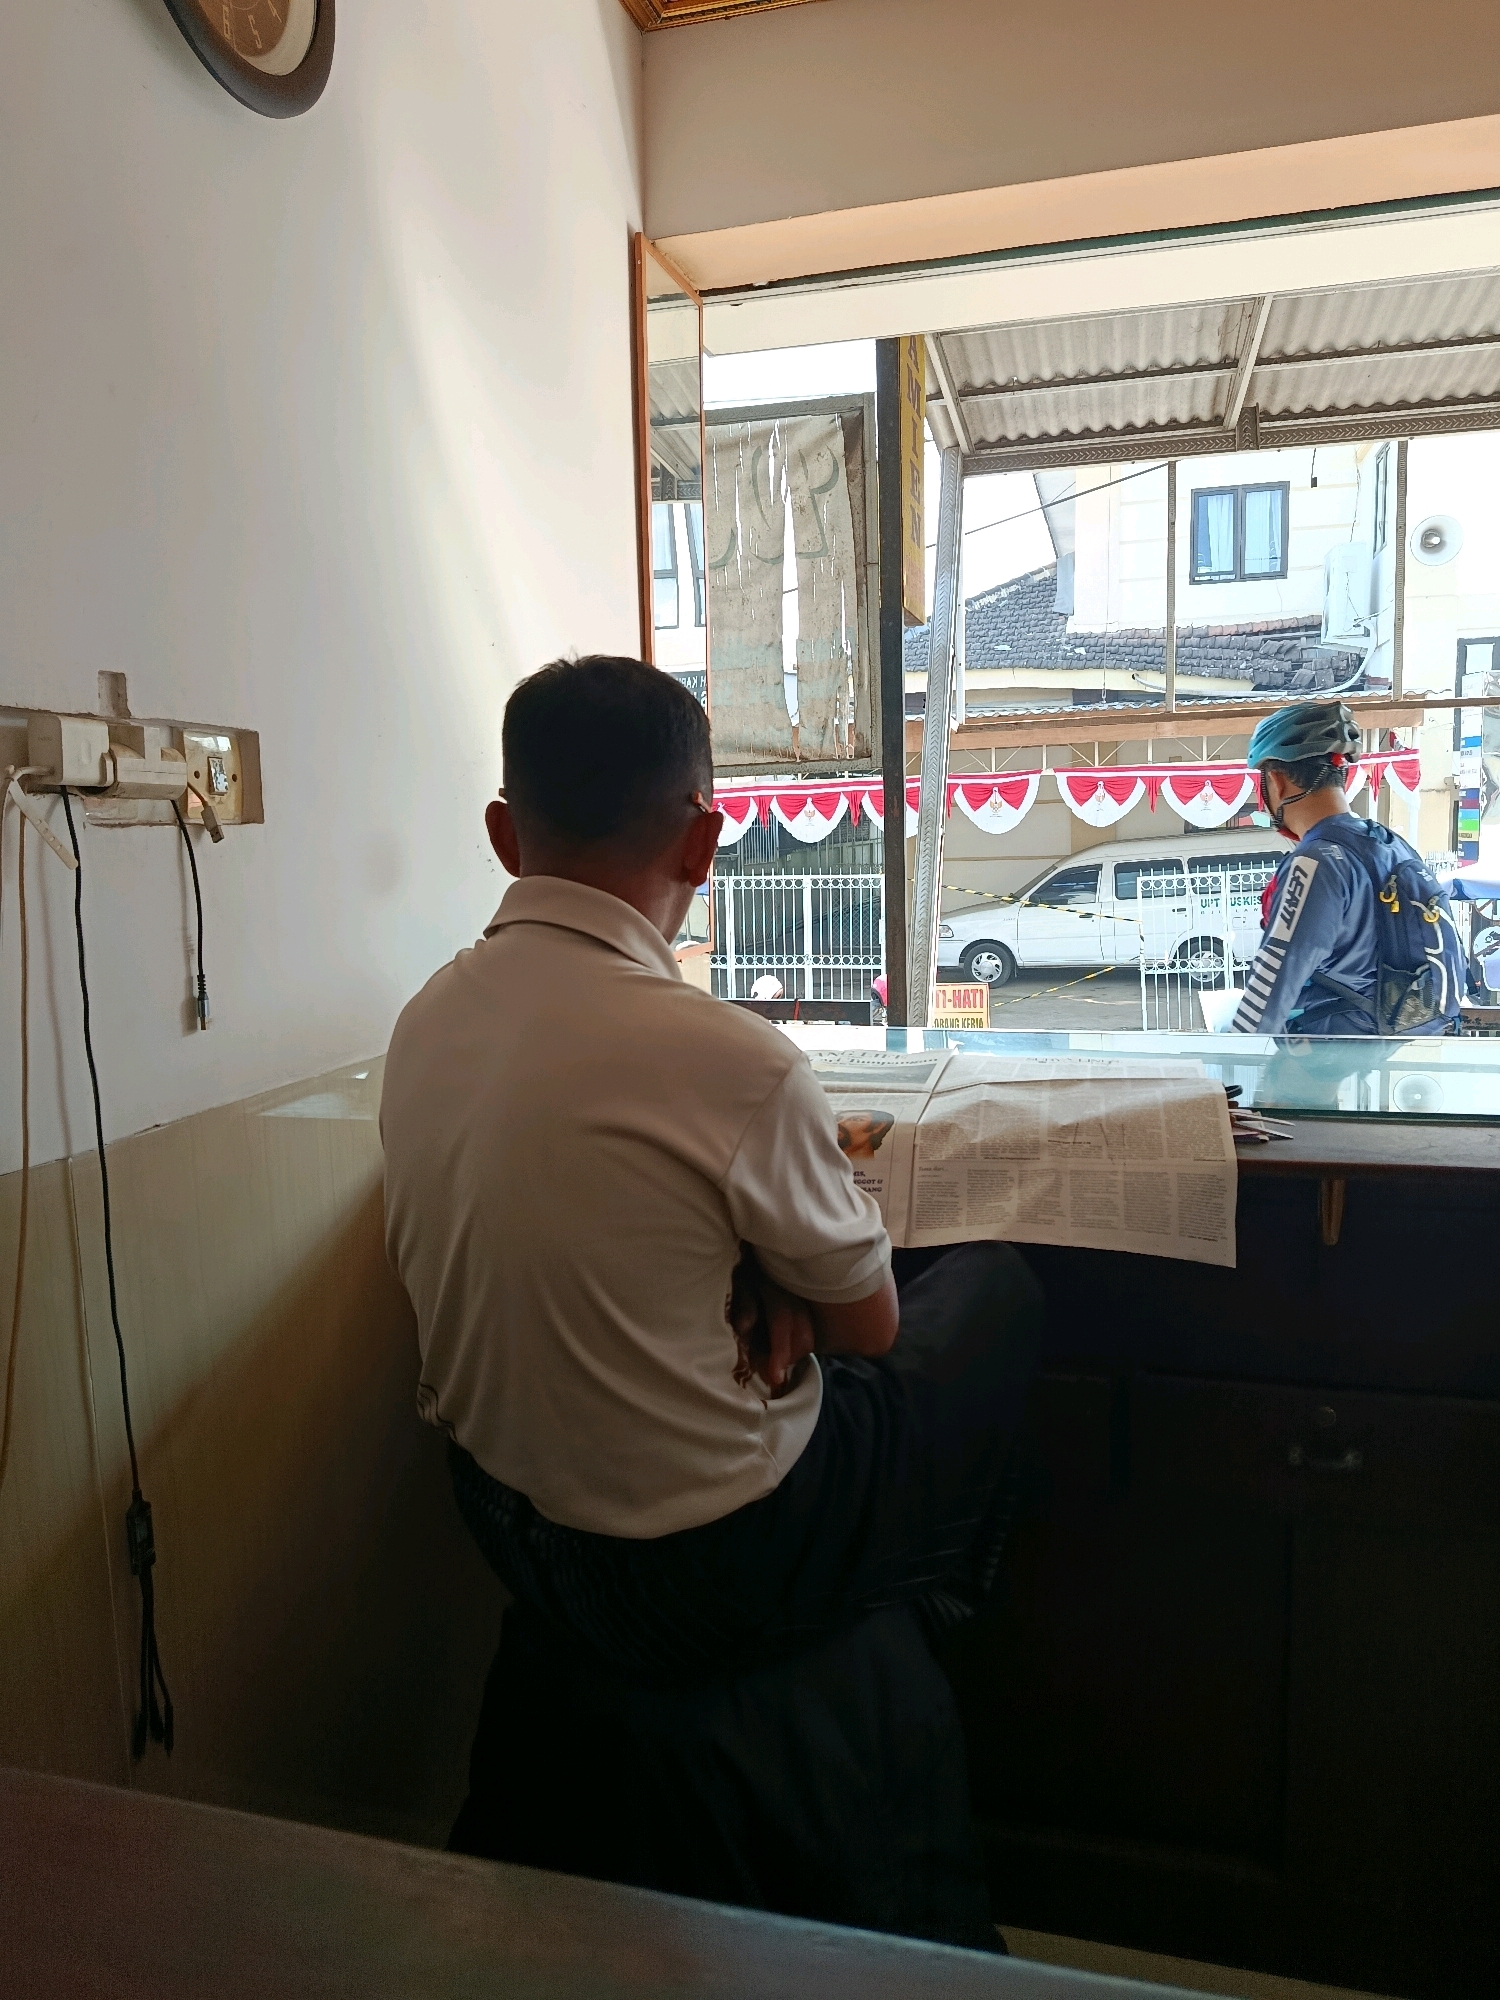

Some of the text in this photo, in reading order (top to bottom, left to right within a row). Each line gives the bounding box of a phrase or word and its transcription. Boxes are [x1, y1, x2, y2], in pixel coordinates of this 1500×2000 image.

[1200, 895, 1262, 908] UPT USKES
[935, 988, 984, 1009] TI-HATI
